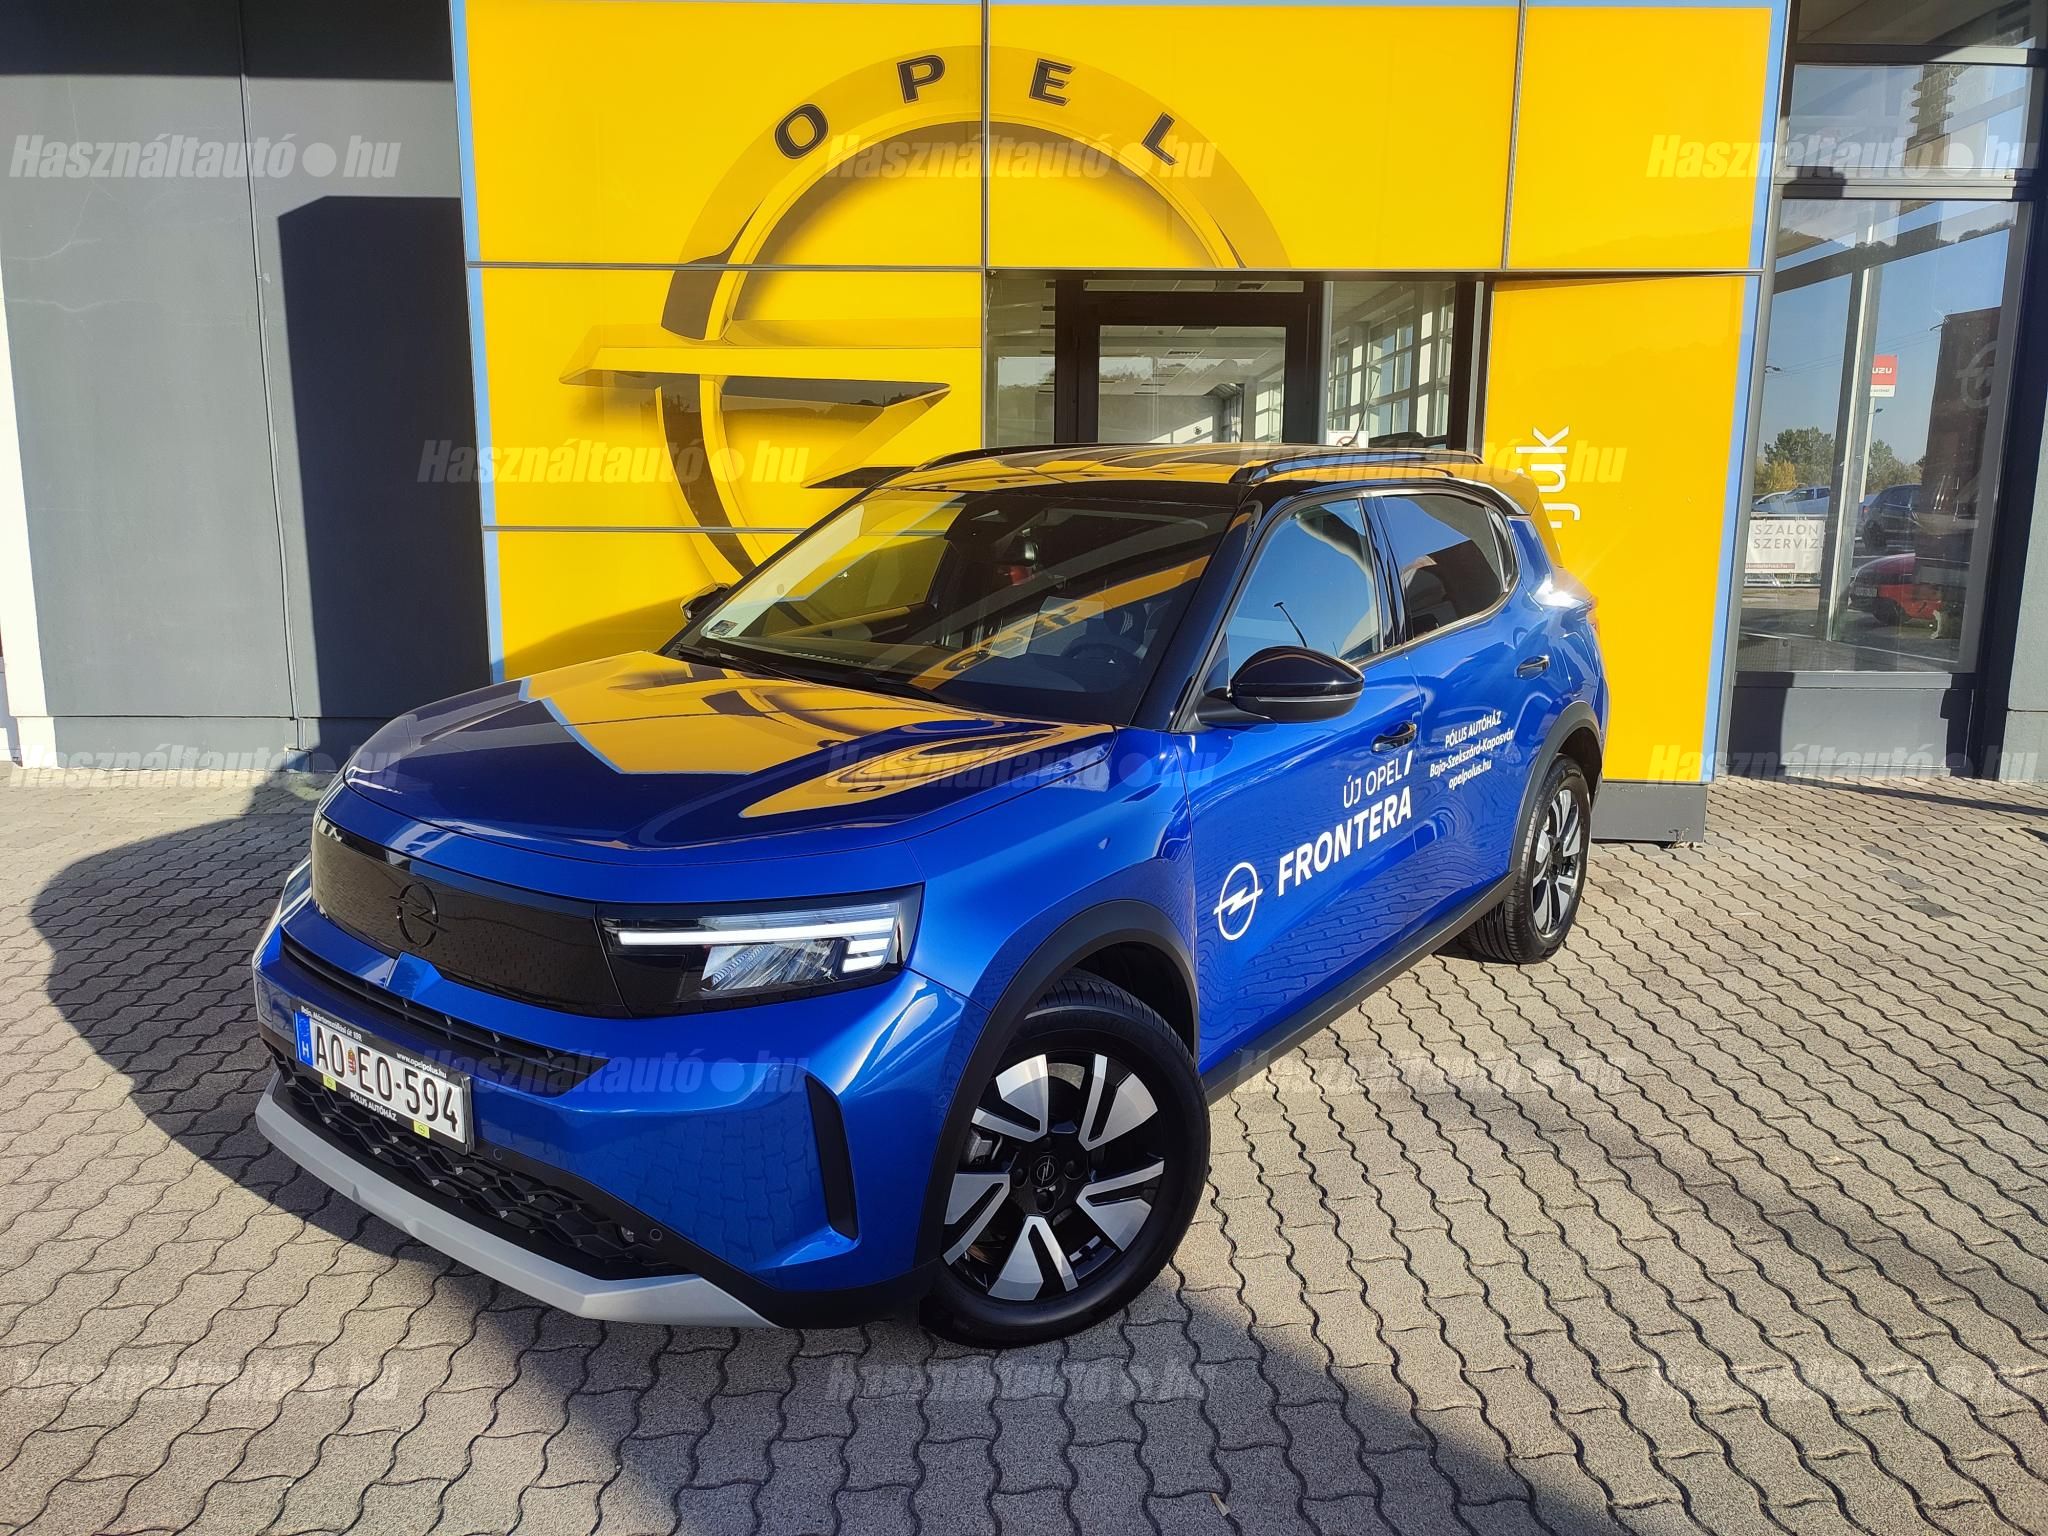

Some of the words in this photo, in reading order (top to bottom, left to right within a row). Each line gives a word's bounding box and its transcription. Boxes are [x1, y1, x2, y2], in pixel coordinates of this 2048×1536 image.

[774, 54, 1181, 166] OPEL
[1753, 538, 1819, 549] SZERVIZ
[1754, 524, 1818, 535] SZALON
[1444, 728, 1467, 749] PÓLUS
[1468, 709, 1502, 738] AUTÓHÁZ
[1343, 774, 1362, 809] ÚJ
[1365, 757, 1403, 795] OPEL
[1448, 758, 1492, 791] opelpolus.hu
[1278, 785, 1413, 897] FRONTERA
[350, 1092, 368, 1107] PÓLUS
